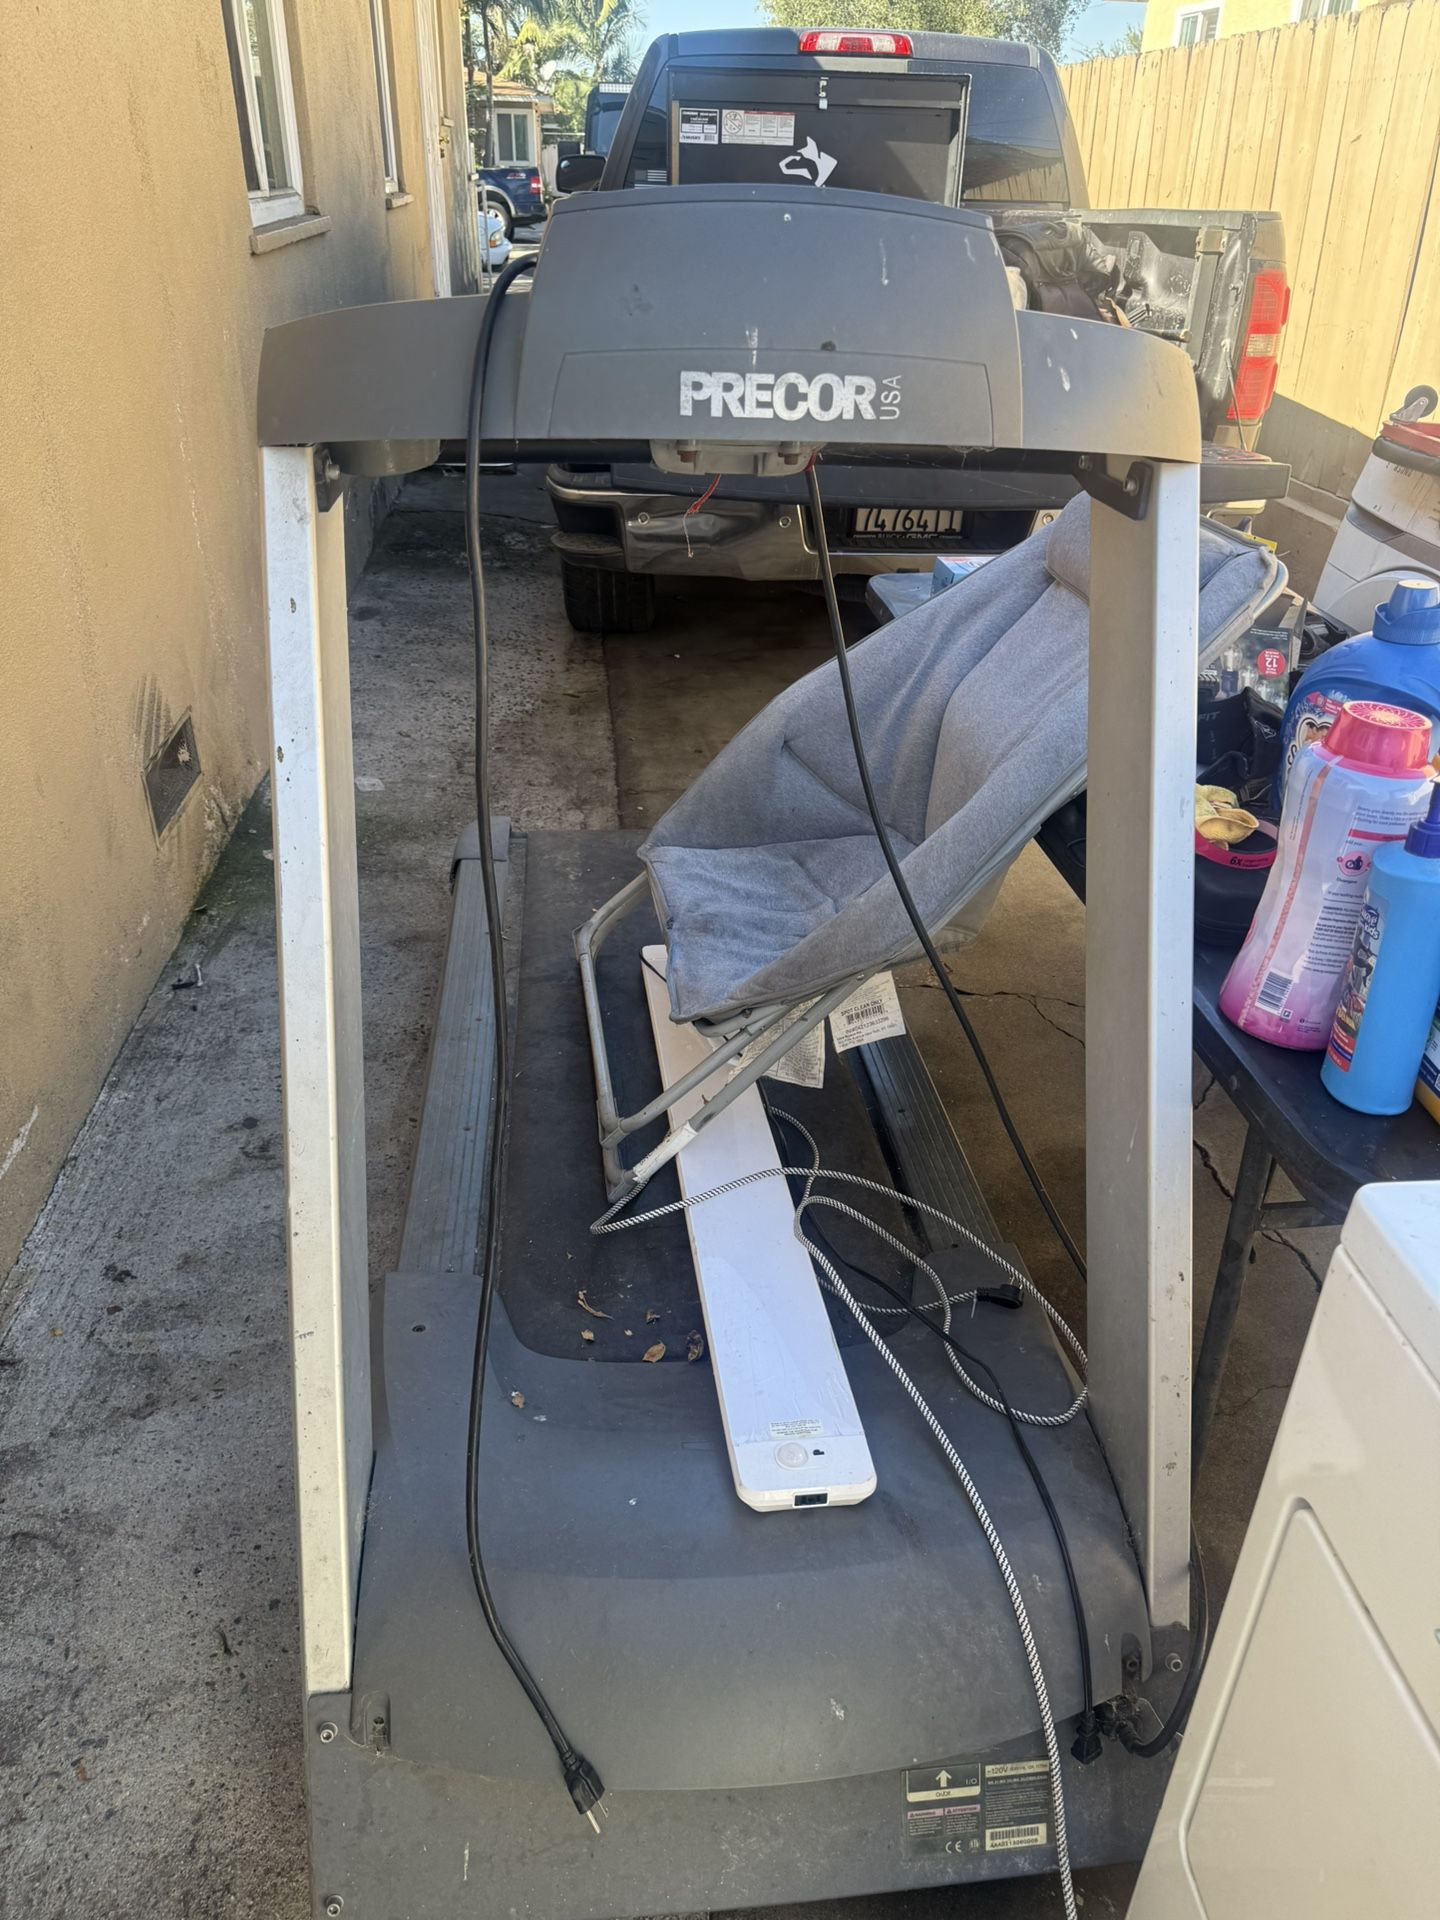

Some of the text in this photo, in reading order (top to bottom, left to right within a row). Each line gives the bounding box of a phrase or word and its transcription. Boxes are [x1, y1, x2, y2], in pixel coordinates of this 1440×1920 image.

[679, 370, 877, 421] PRECOR
[879, 375, 902, 420] USA
[1265, 658, 1279, 668] 12
[854, 1003, 870, 1011] CLEAN
